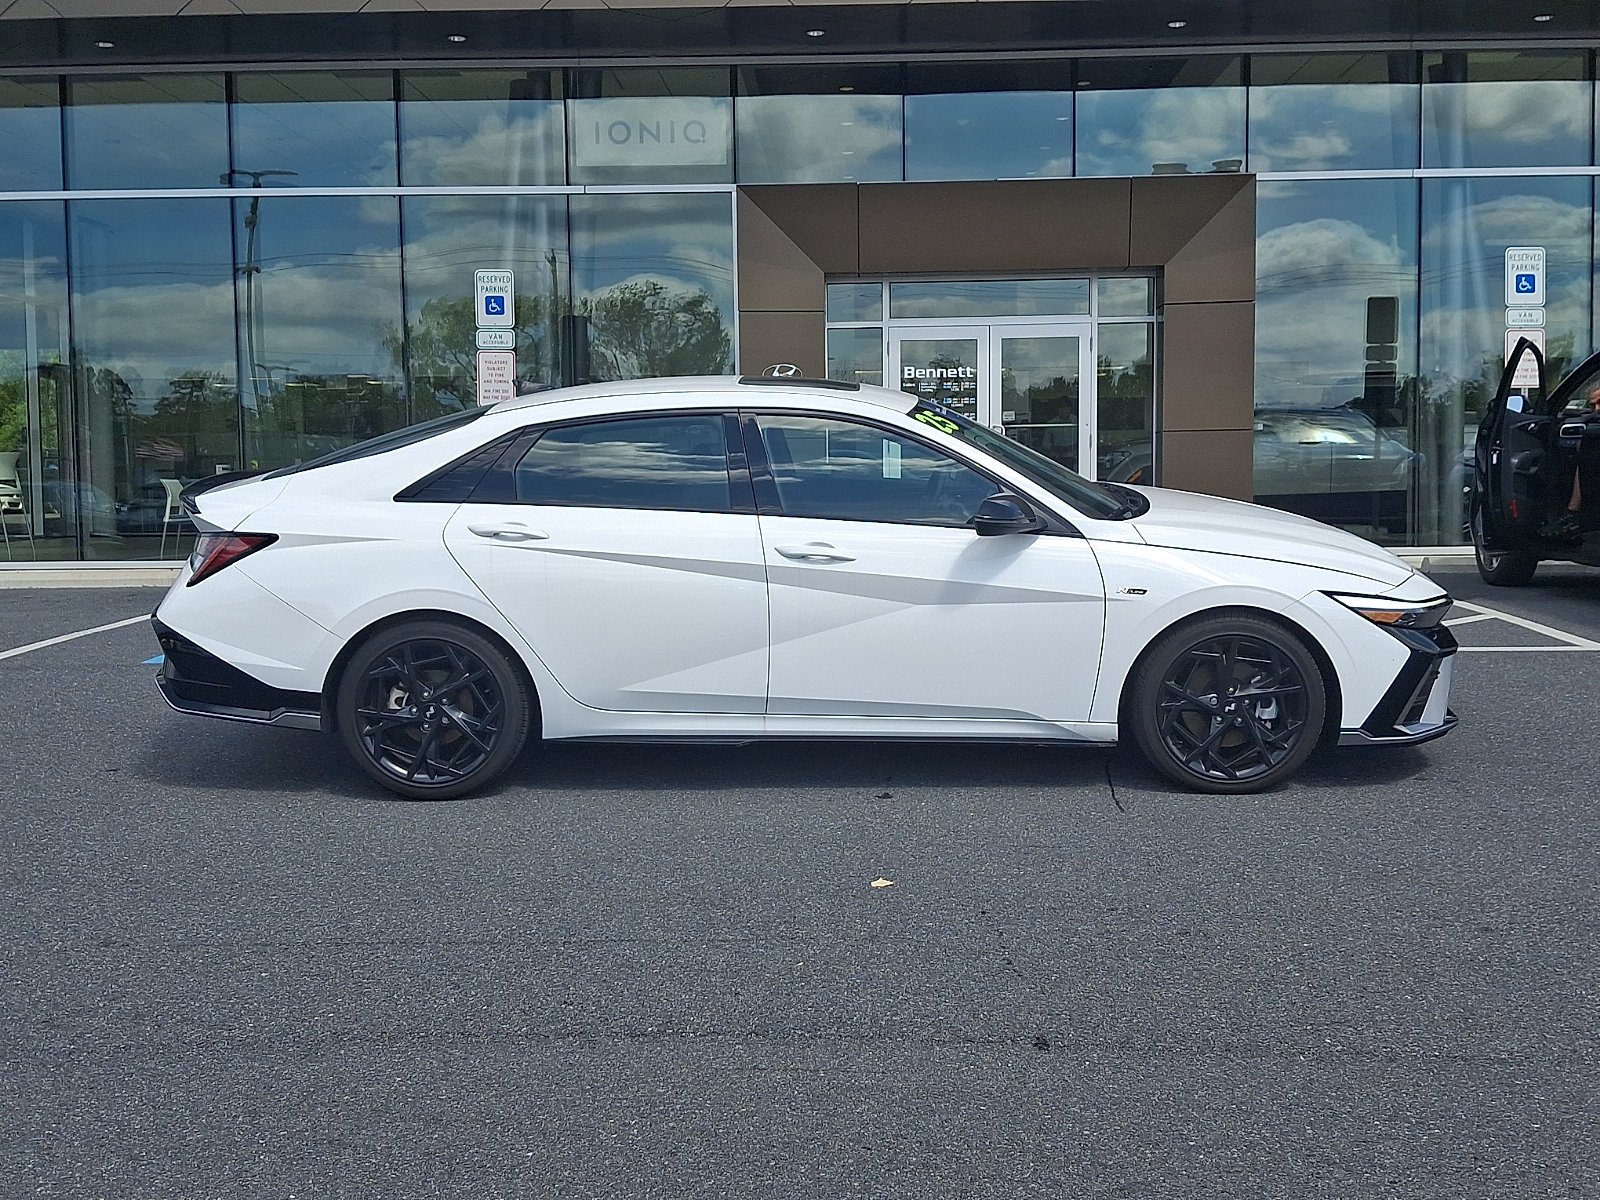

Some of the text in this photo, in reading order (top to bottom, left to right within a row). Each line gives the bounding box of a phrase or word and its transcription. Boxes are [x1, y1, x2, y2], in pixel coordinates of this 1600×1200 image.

[594, 119, 706, 145] IONIQ
[1509, 253, 1542, 262] RESERVED
[1511, 263, 1540, 271] PARKING
[478, 275, 511, 284] RESERVED
[480, 285, 509, 294] PARKING
[903, 366, 974, 379] Bennett
